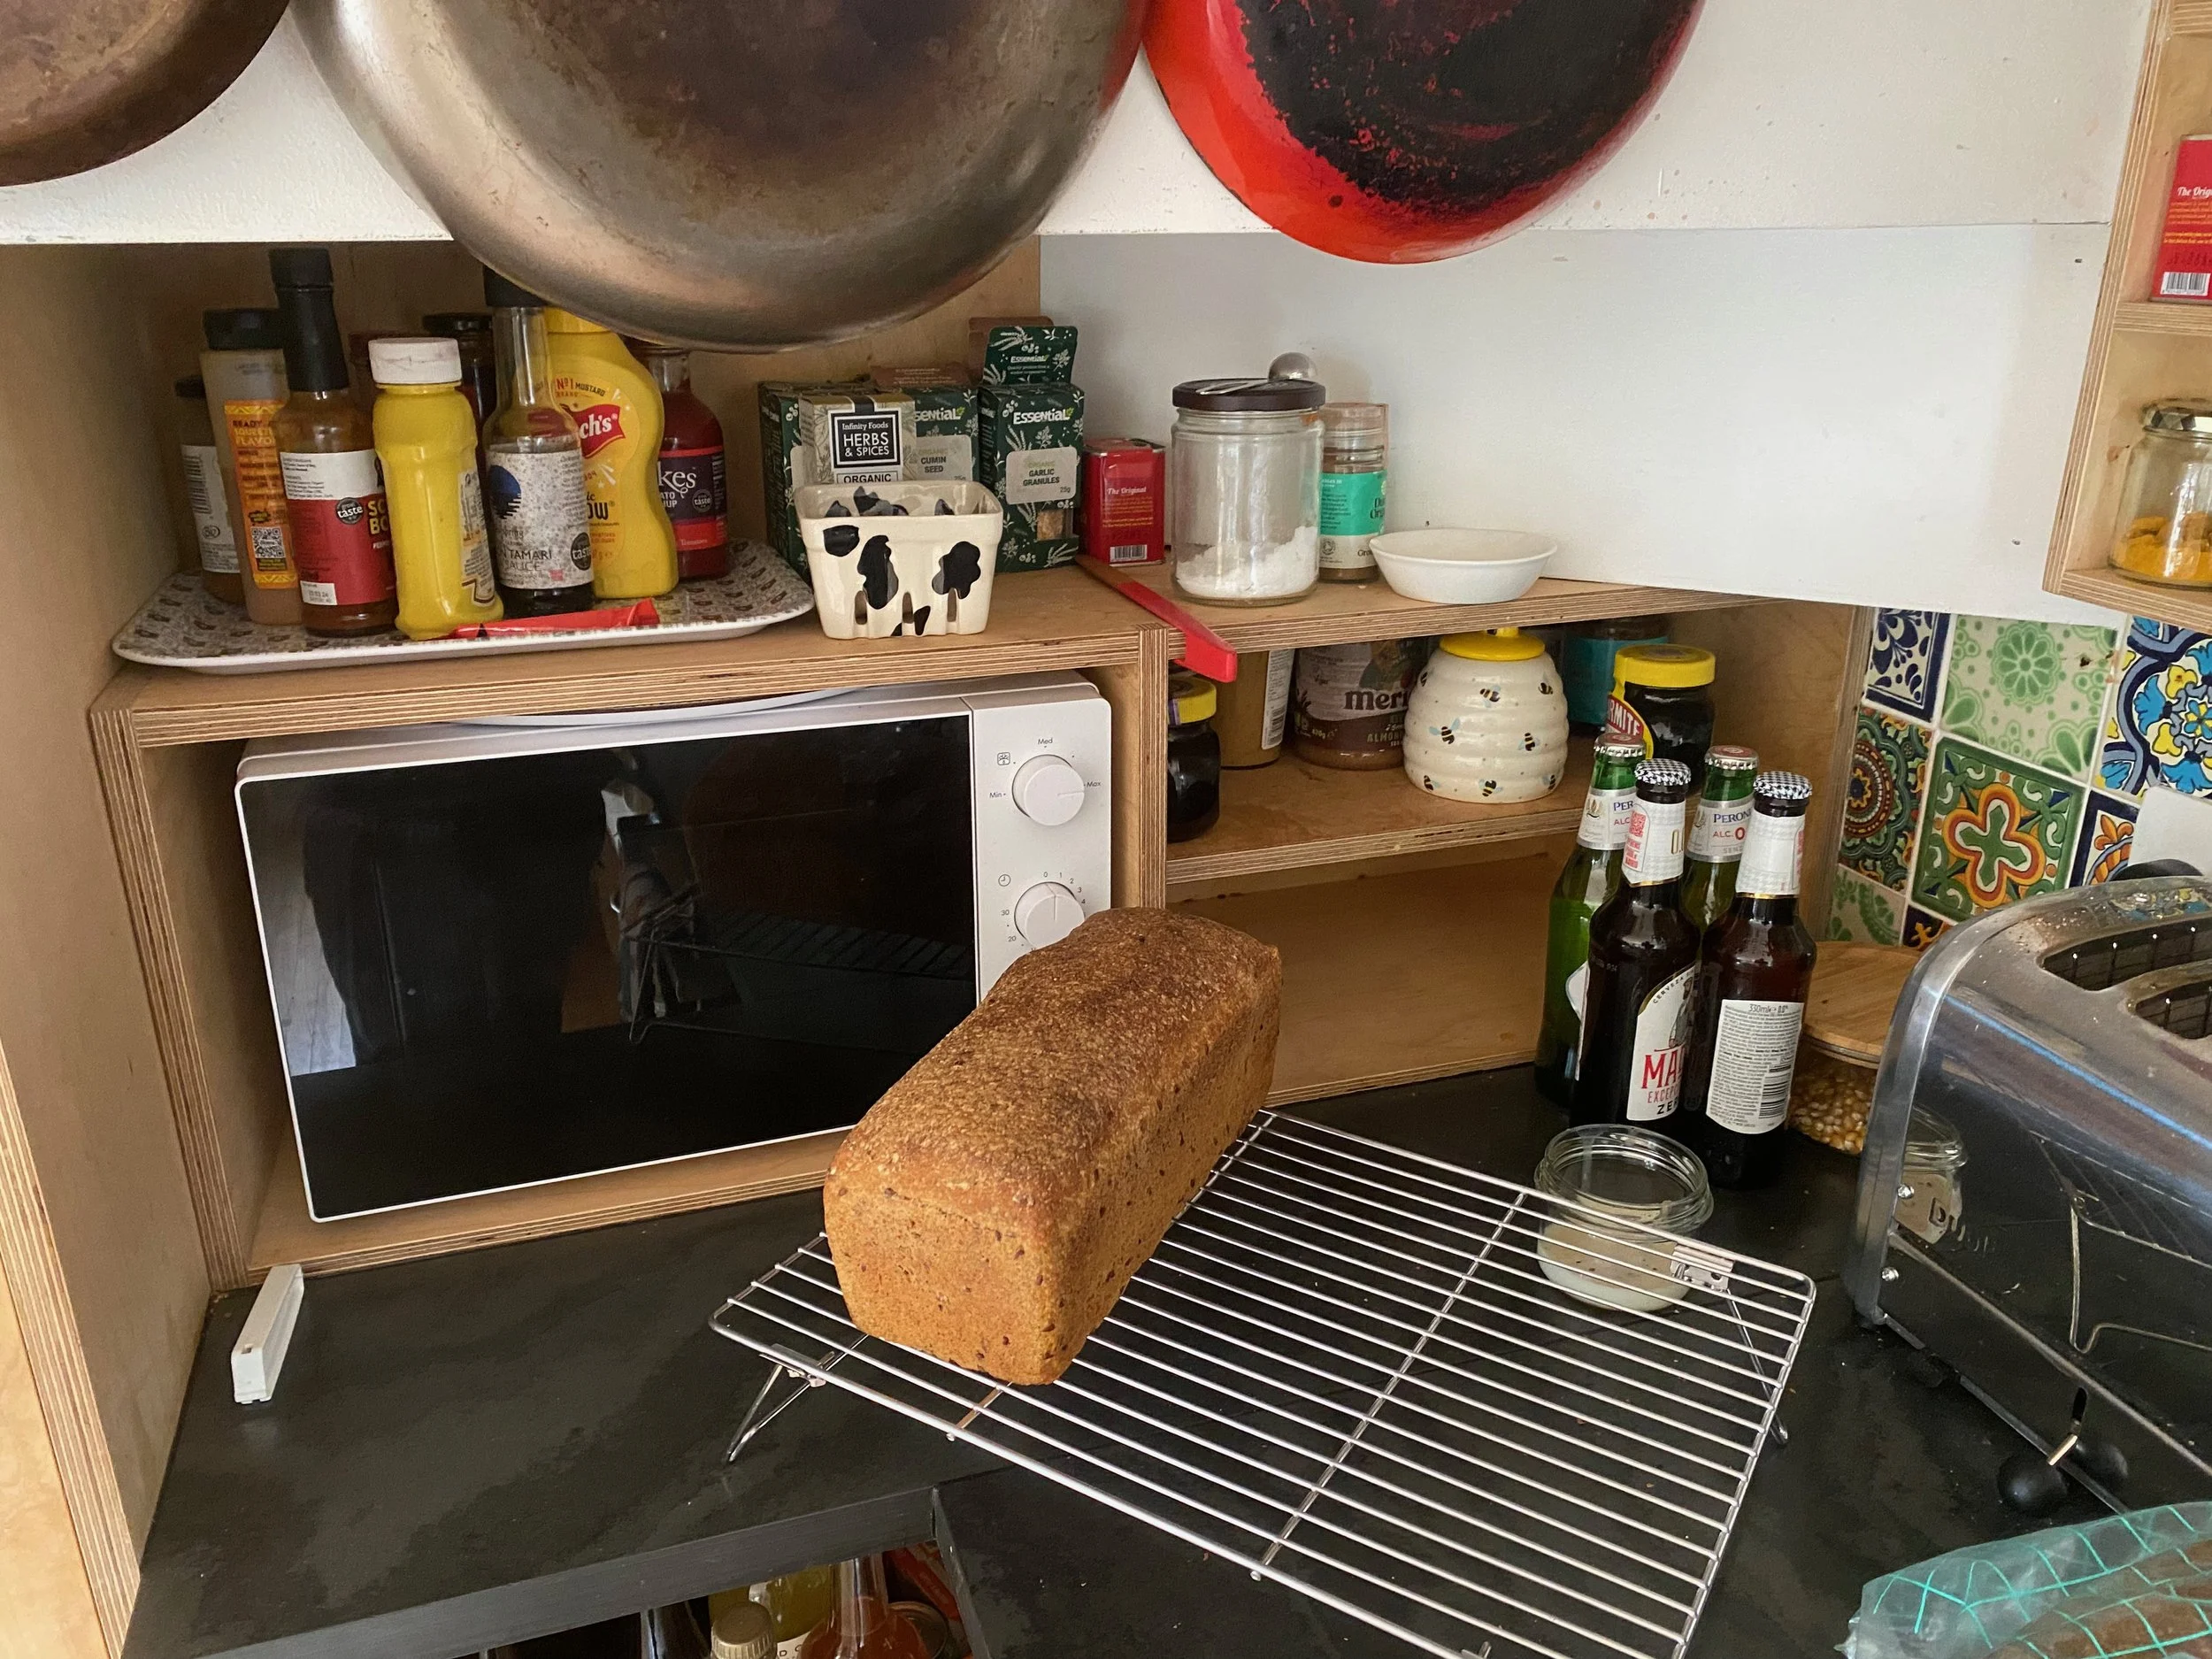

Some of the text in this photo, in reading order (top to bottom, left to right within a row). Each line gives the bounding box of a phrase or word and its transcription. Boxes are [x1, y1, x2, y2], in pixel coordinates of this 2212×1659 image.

[2177, 186, 2212, 199] The Orig
[575, 382, 606, 396] MUSTARD
[1013, 408, 1071, 425] Essential
[843, 432, 889, 447] HERBS
[845, 446, 889, 457] & SPICES
[920, 456, 947, 465] CUMIN
[843, 473, 892, 483] ORGANIC
[1023, 477, 1060, 487] GRANULES
[1121, 487, 1147, 495] Original
[337, 505, 363, 518] taste
[510, 549, 552, 560] TAMARI
[1652, 977, 1684, 1004] CERVEZA
